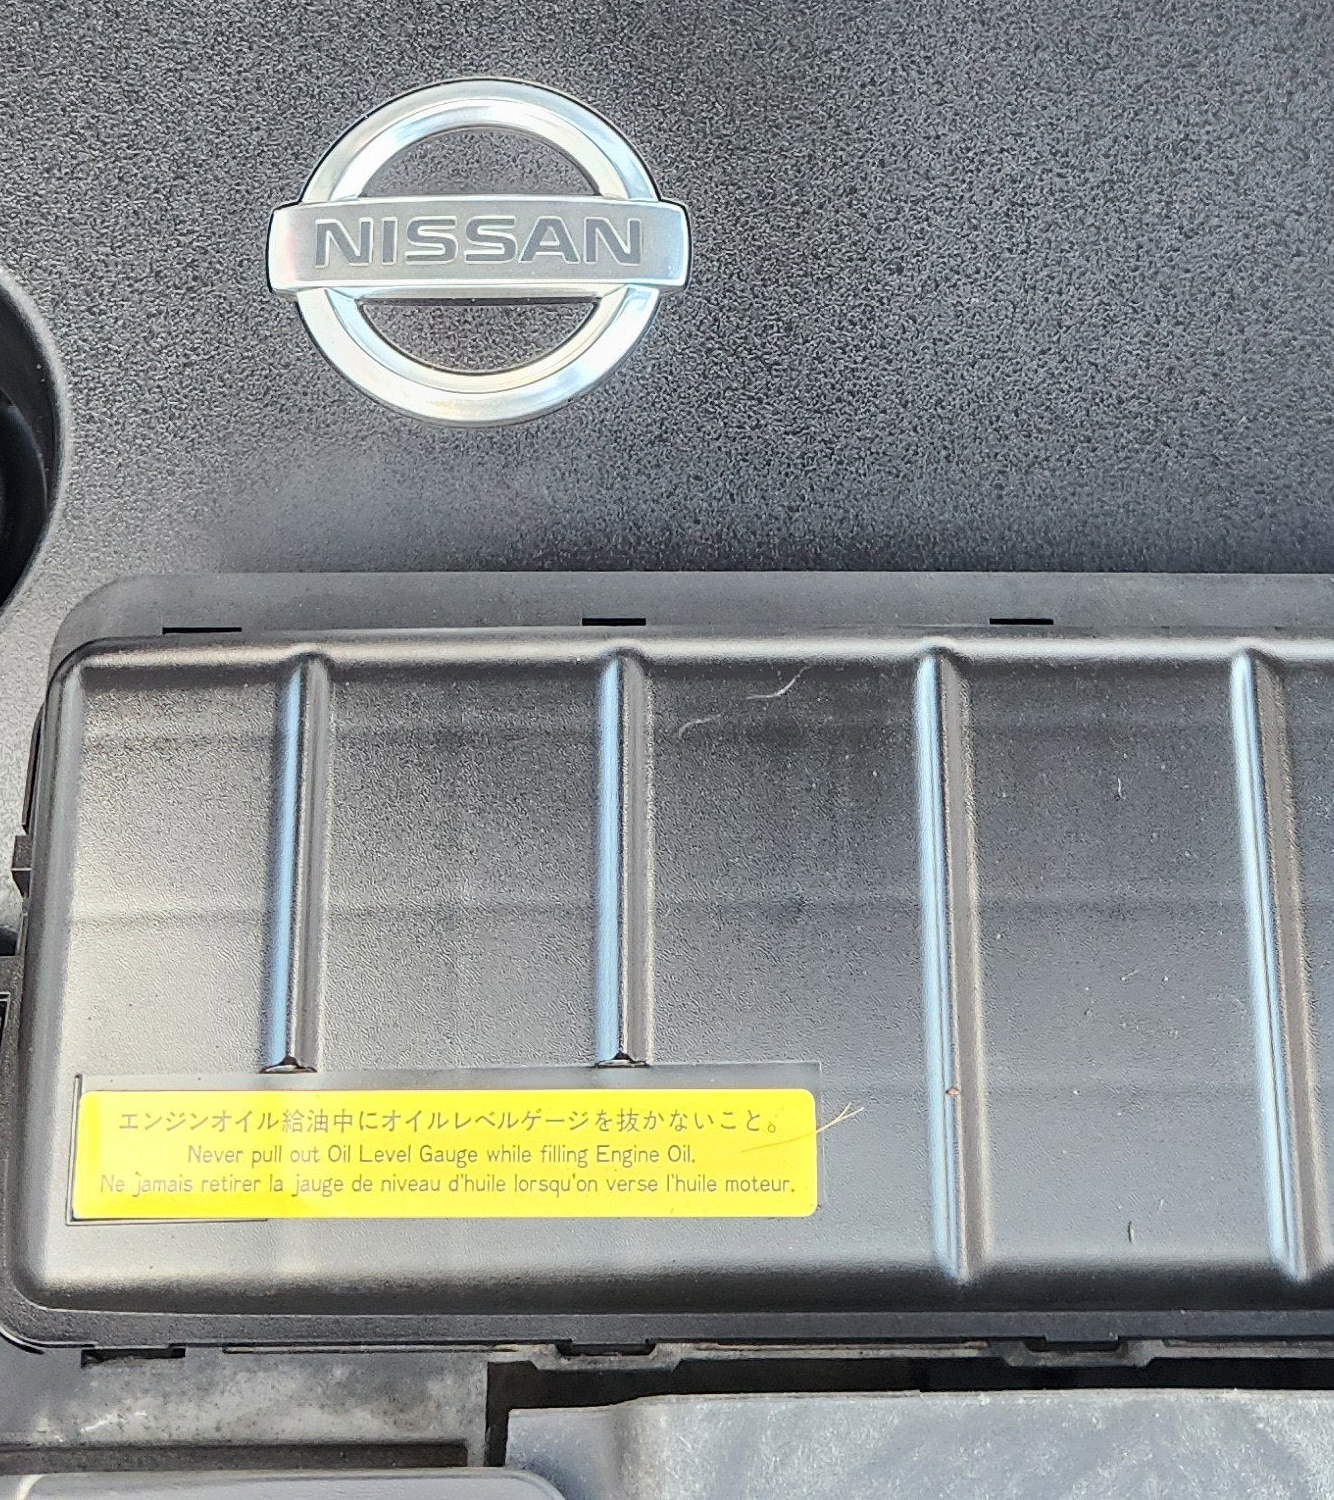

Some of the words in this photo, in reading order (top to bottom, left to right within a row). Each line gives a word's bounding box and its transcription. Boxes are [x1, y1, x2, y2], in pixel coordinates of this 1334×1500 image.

[314, 214, 642, 268] NISSAN
[119, 1108, 776, 1134] エンジンオイル給油中にオイルレベルゲージを抜かないこと。
[188, 1145, 244, 1164] Never
[251, 1145, 282, 1169] pull
[290, 1147, 320, 1164] out
[328, 1145, 351, 1164] Oil
[359, 1144, 411, 1164] Level
[420, 1144, 478, 1169] Gauge
[487, 1145, 531, 1164] while
[540, 1144, 588, 1169] filling
[597, 1145, 660, 1169] Engine
[668, 1144, 696, 1164] Oil.
[100, 1174, 125, 1193] Ne
[132, 1172, 193, 1198] jamais
[201, 1174, 262, 1193] retirer
[269, 1173, 283, 1193] la
[291, 1174, 343, 1198] jauge
[352, 1174, 373, 1193] de
[381, 1174, 440, 1193] niveau
[448, 1173, 505, 1193] d'huile
[514, 1173, 598, 1199] lorsqu'on
[606, 1178, 658, 1193] verse
[667, 1173, 717, 1193] l'huile
[726, 1175, 796, 1193] moteur.
